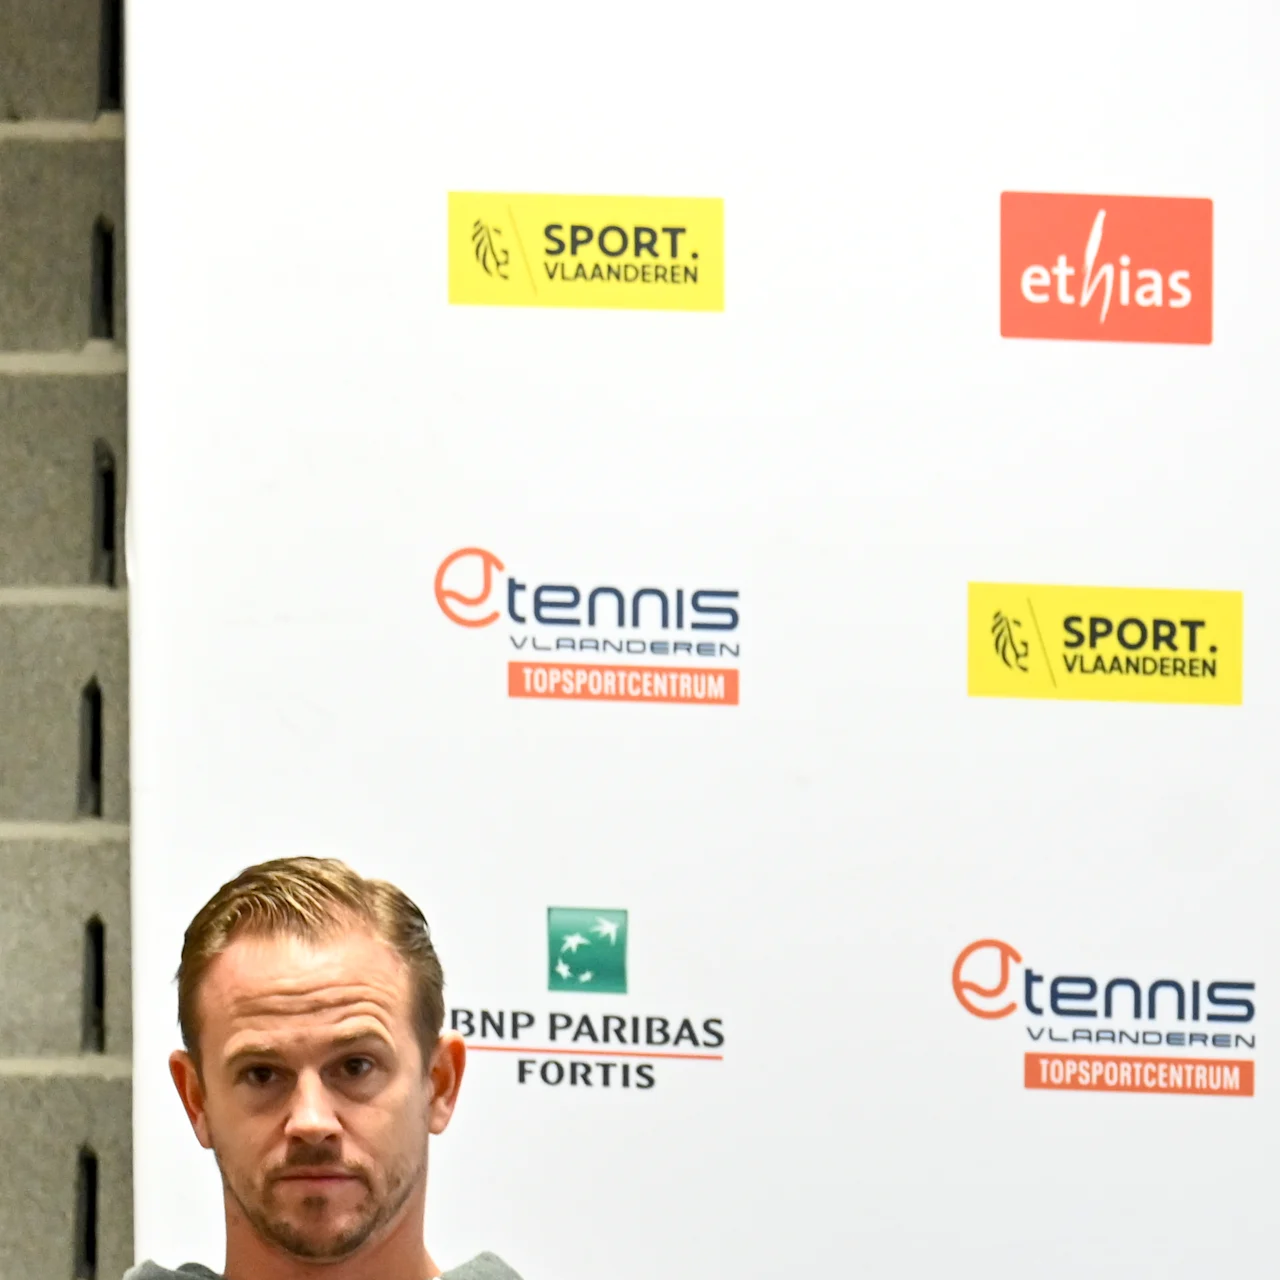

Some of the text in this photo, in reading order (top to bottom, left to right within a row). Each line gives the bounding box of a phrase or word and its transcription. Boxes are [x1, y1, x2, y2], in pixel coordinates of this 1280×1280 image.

[543, 223, 699, 260] SPORT.
[543, 261, 698, 284] VLAANDEREN
[1020, 209, 1192, 323] ethias
[507, 577, 740, 631] tennis
[509, 635, 740, 658] VLAANDEREN
[1063, 615, 1218, 654] SPORT.
[1062, 654, 1217, 678] VLAANDEREN
[523, 667, 725, 699] TOPSPORTCENTRUM
[1024, 968, 1256, 1024] tennis
[451, 1009, 725, 1049] BNP PARIBAS
[1026, 1026, 1256, 1050] VLAANDEREN
[517, 1059, 656, 1090] FORTIS
[1039, 1058, 1240, 1090] TOPSPORTCENTRUM
